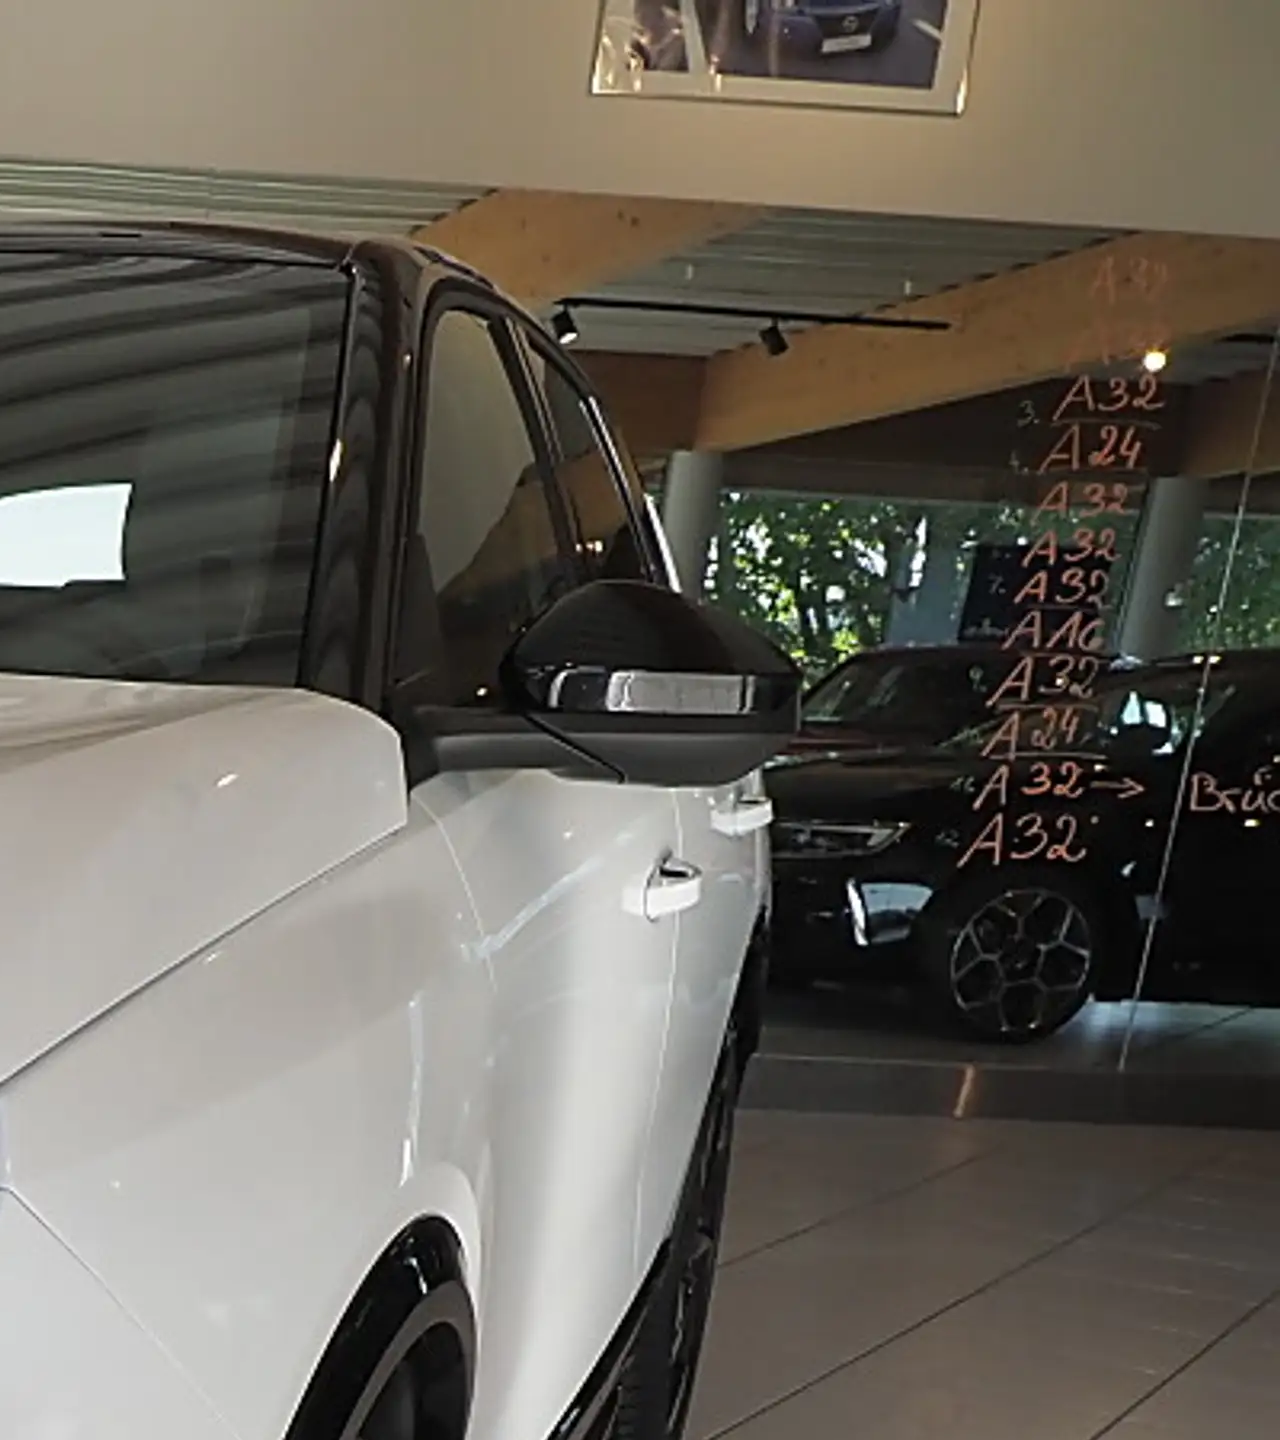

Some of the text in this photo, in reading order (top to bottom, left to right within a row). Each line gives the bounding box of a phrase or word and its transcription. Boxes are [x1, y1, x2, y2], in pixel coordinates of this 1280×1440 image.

[1052, 373, 1167, 421] A32
[1039, 422, 1142, 475] A24
[1031, 480, 1132, 526] A32
[1021, 527, 1122, 569] A32
[1013, 568, 1113, 611] A32
[985, 654, 1100, 708] A32
[979, 703, 1082, 762] A24
[971, 761, 1085, 811] A32
[956, 811, 1088, 868] A32
